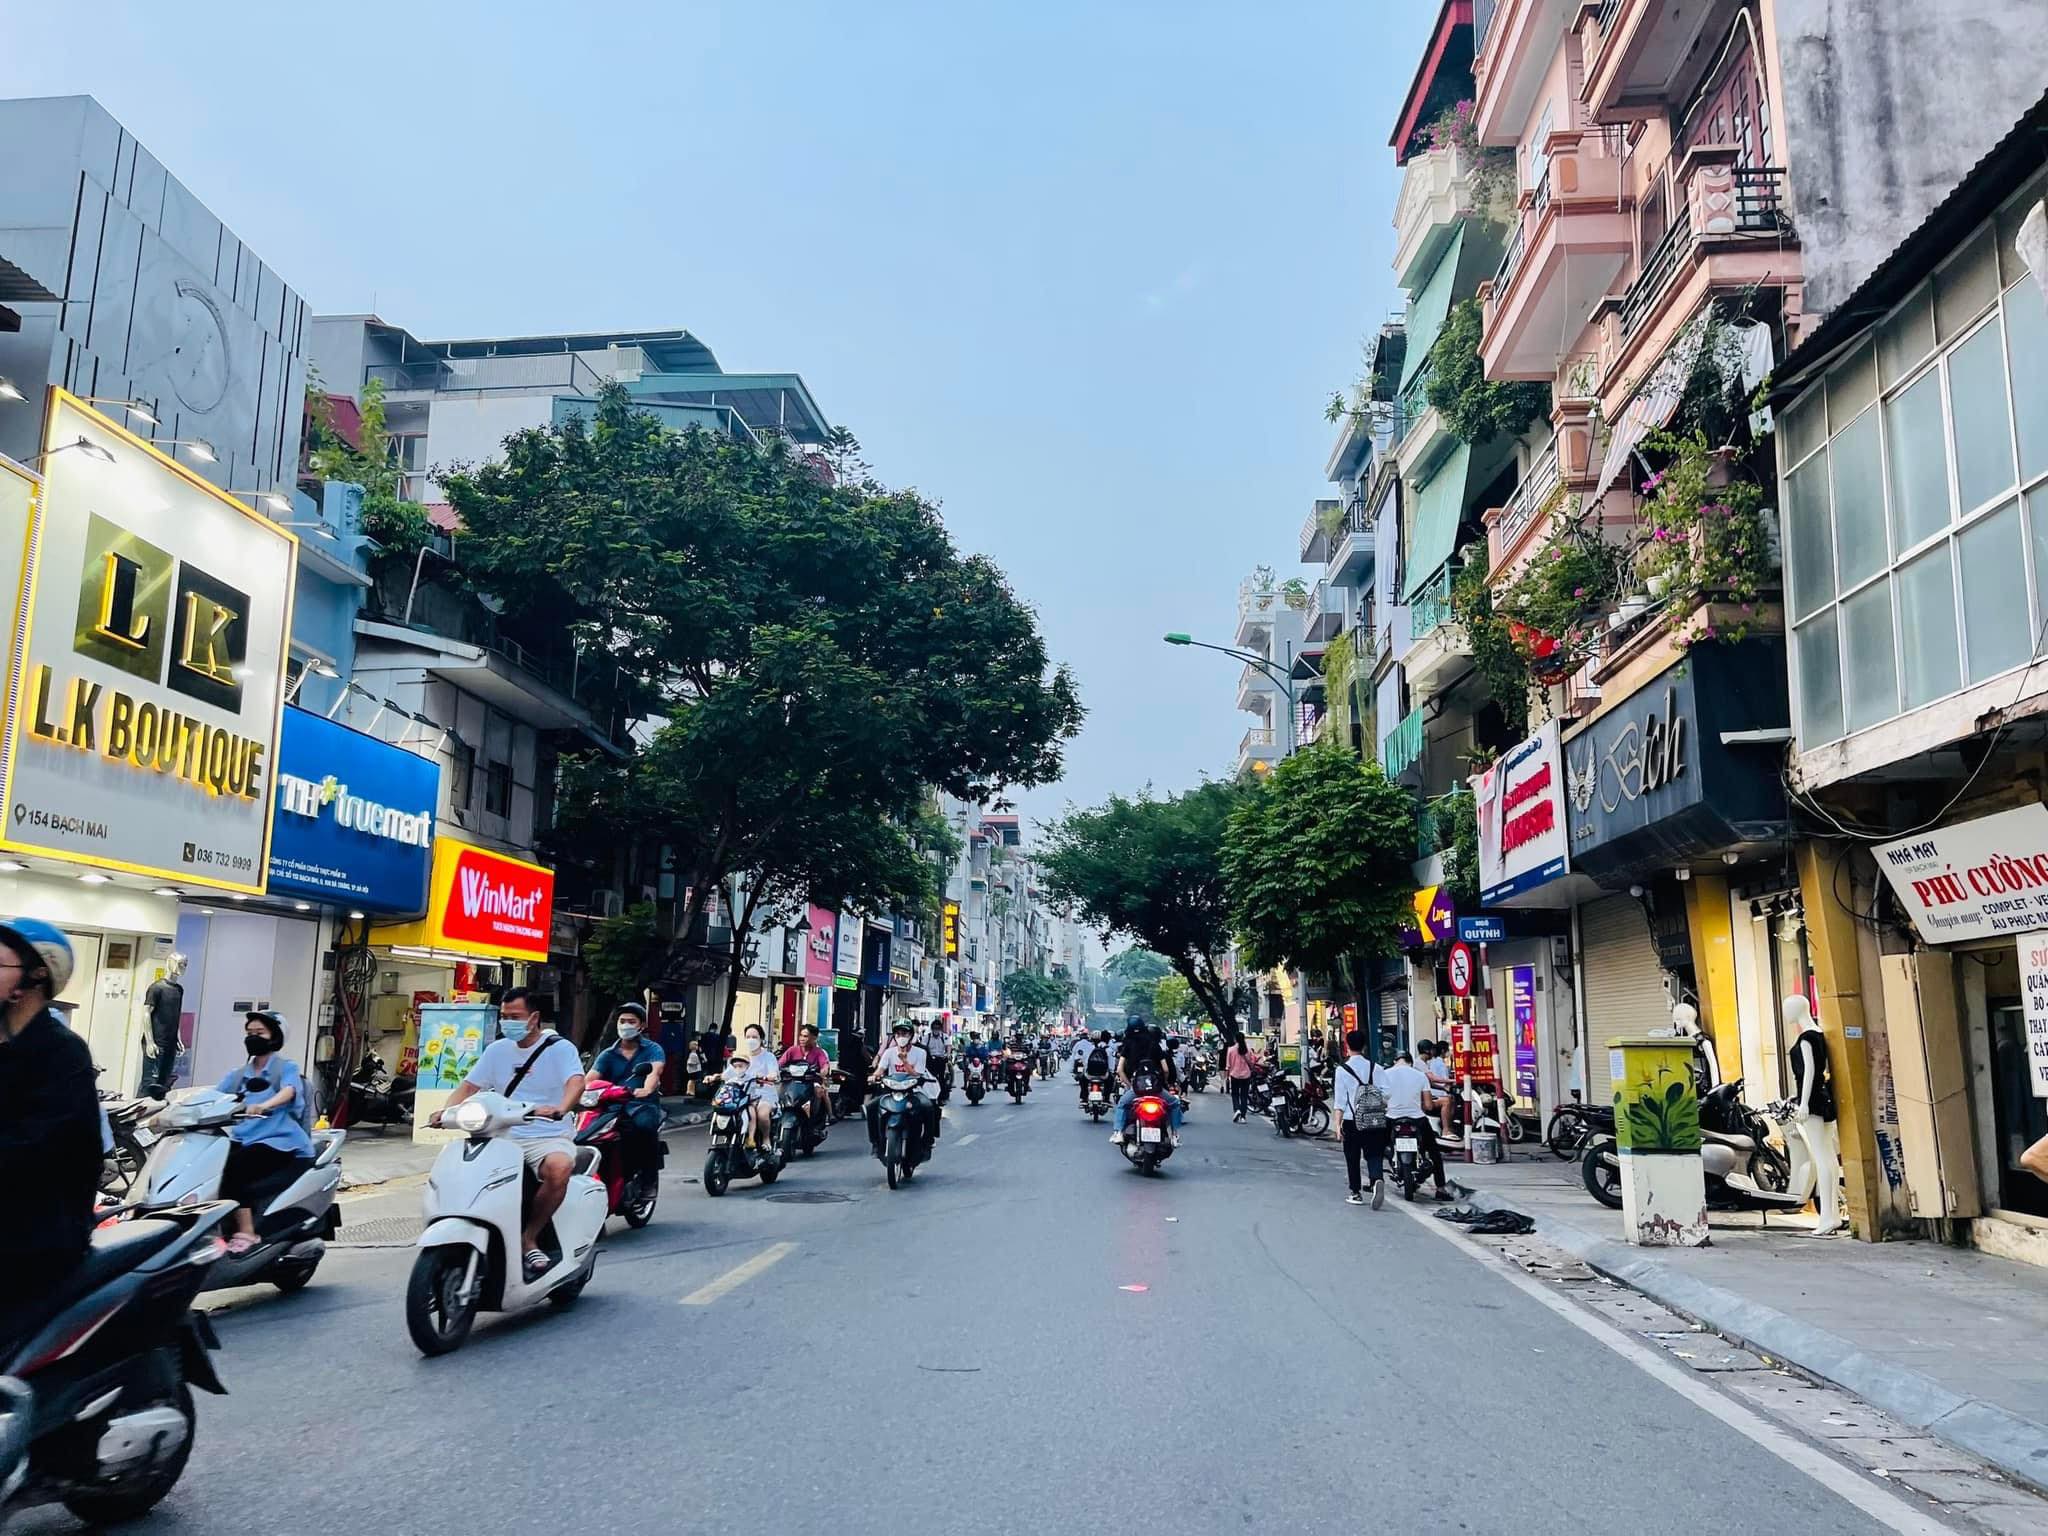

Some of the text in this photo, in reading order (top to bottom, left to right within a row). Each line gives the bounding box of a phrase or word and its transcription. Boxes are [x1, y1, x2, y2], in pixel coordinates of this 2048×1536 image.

[29, 664, 265, 800] L.K BOUTIQUE
[29, 811, 107, 840] 154 BẠCH MAI
[1912, 841, 1938, 859] MAY
[197, 849, 213, 864] 036
[215, 852, 231, 868] 732
[232, 856, 252, 872] 9999
[1912, 864, 1968, 908] PHÚ
[1982, 898, 2028, 915] COMPLET
[2008, 913, 2036, 928] PHỤC
[1465, 927, 1501, 940] QUỲNH
[2029, 1018, 2047, 1034] THAY
